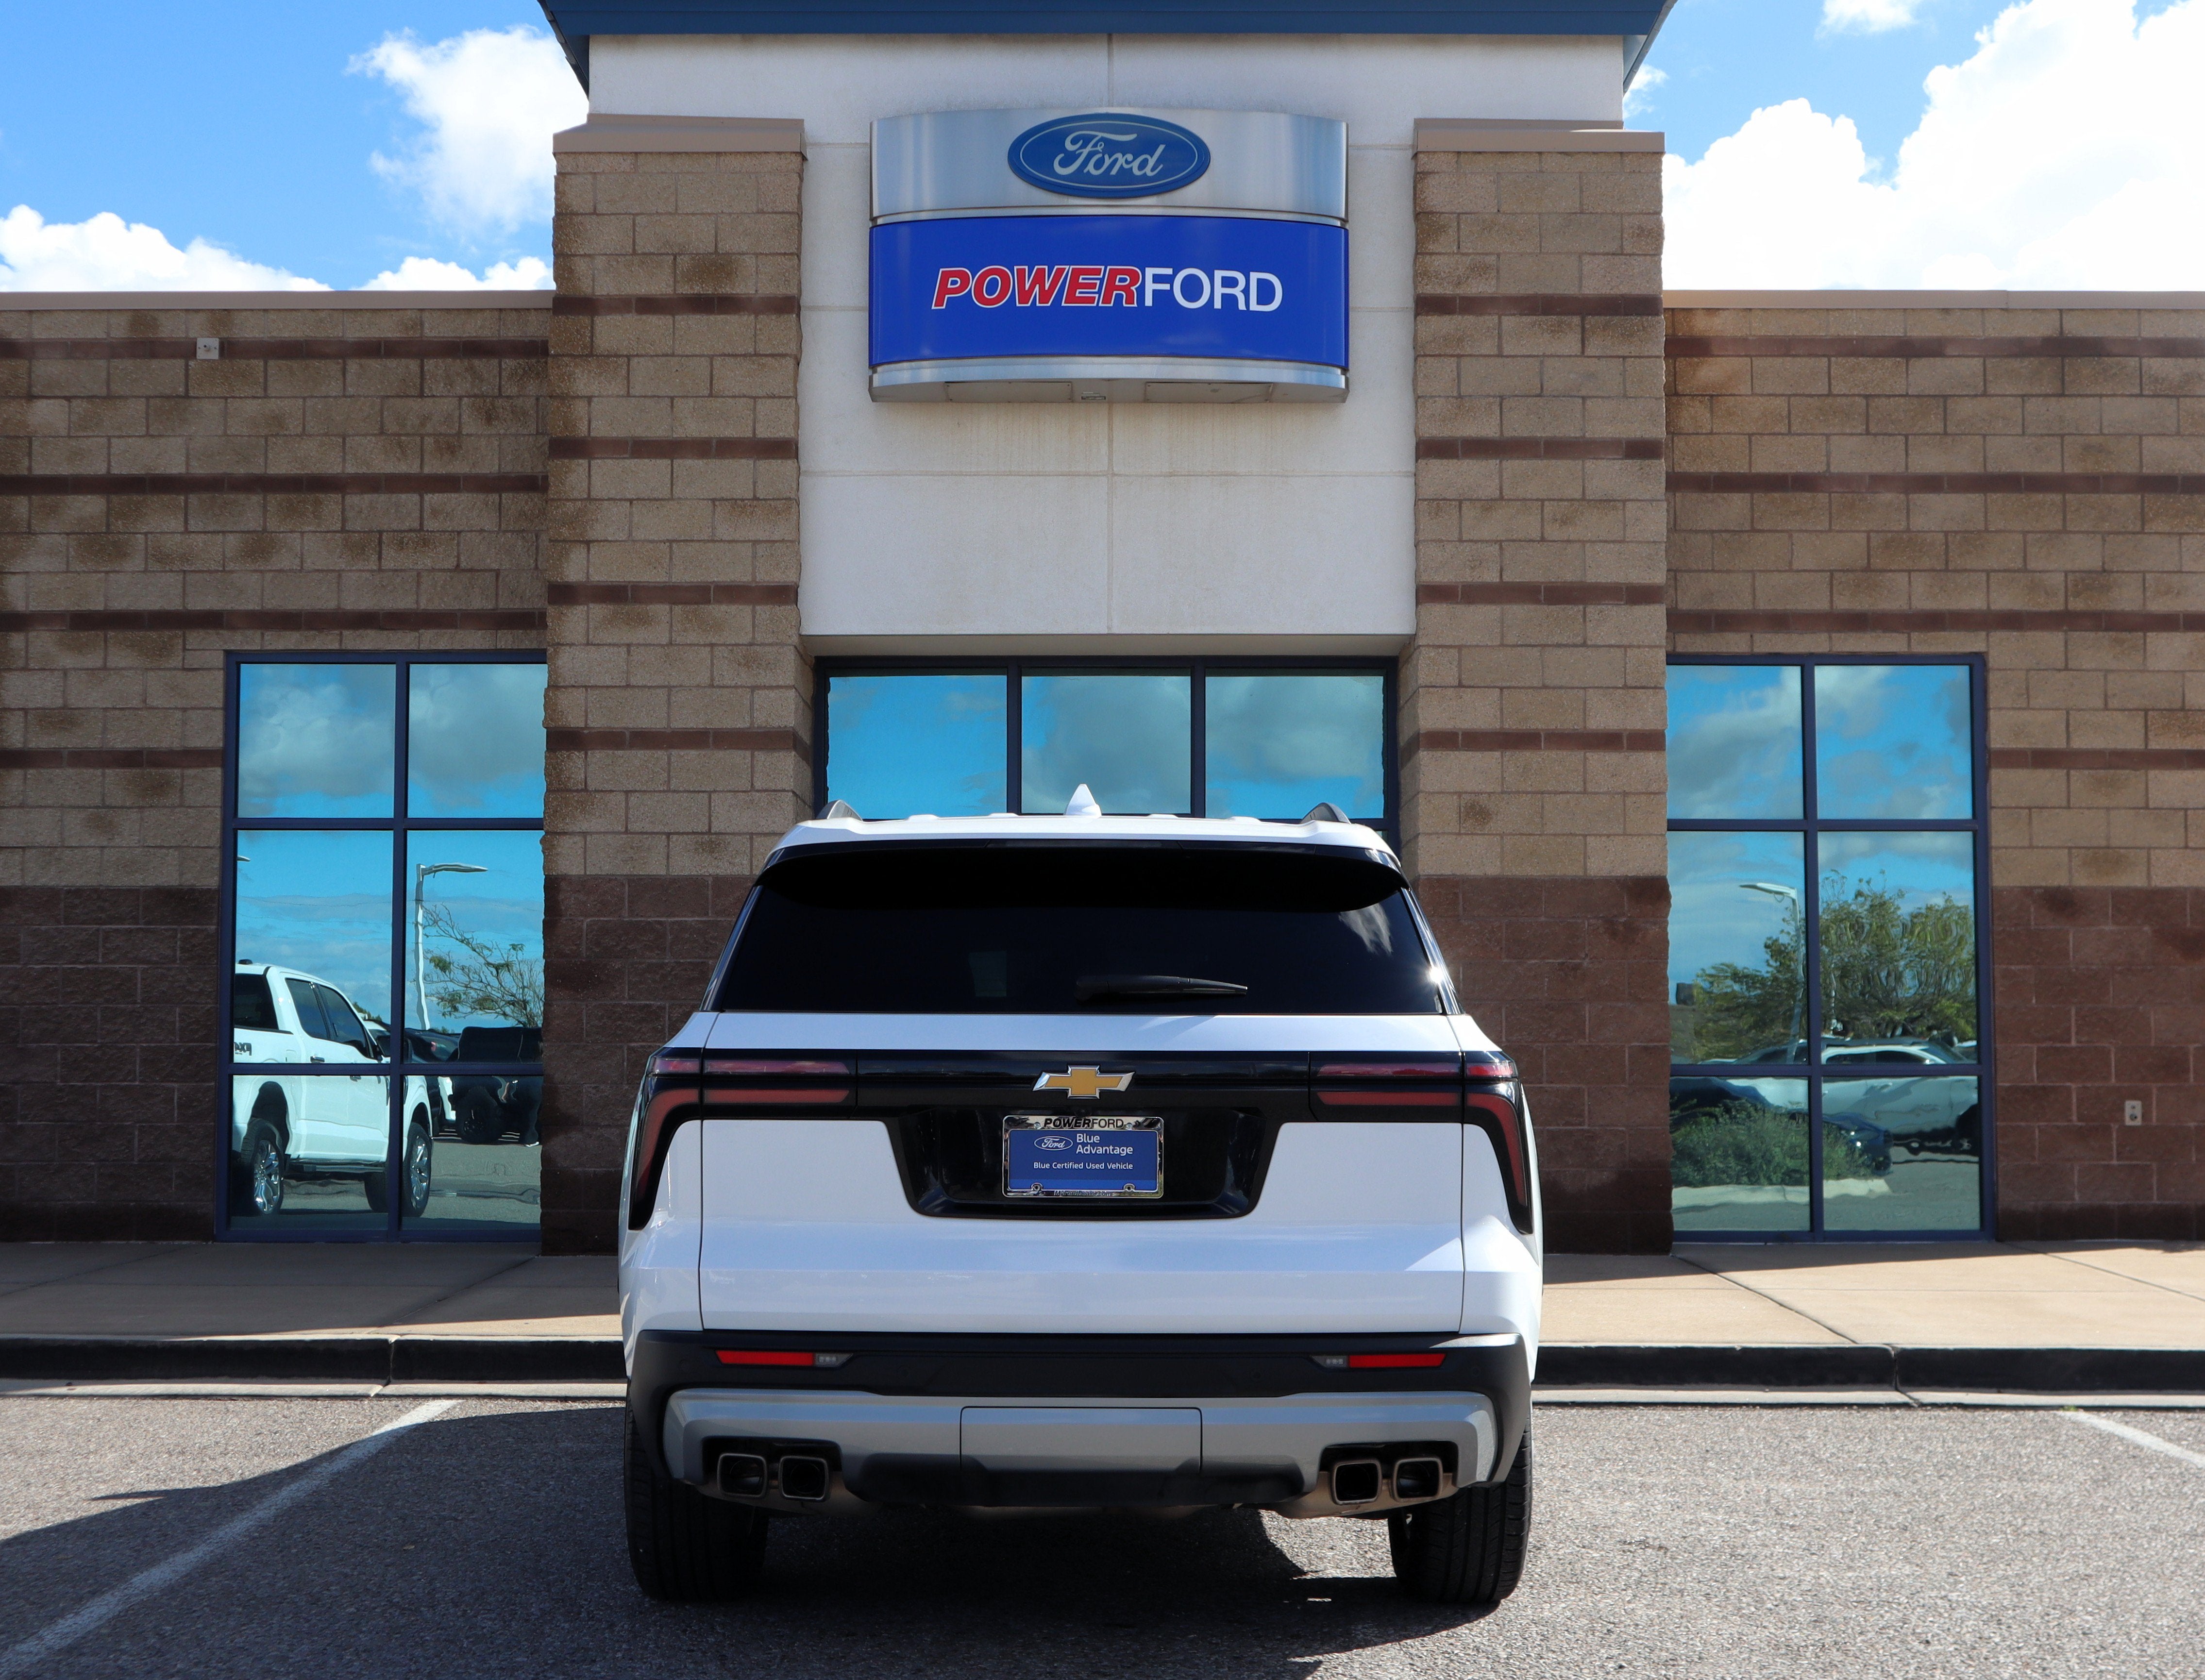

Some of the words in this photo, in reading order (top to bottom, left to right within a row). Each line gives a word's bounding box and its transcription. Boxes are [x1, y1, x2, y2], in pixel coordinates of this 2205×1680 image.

[1053, 131, 1166, 177] Ford
[1042, 1138, 1065, 1148] Ford
[1077, 1133, 1100, 1143] Blue
[1076, 1144, 1133, 1156] Advantage
